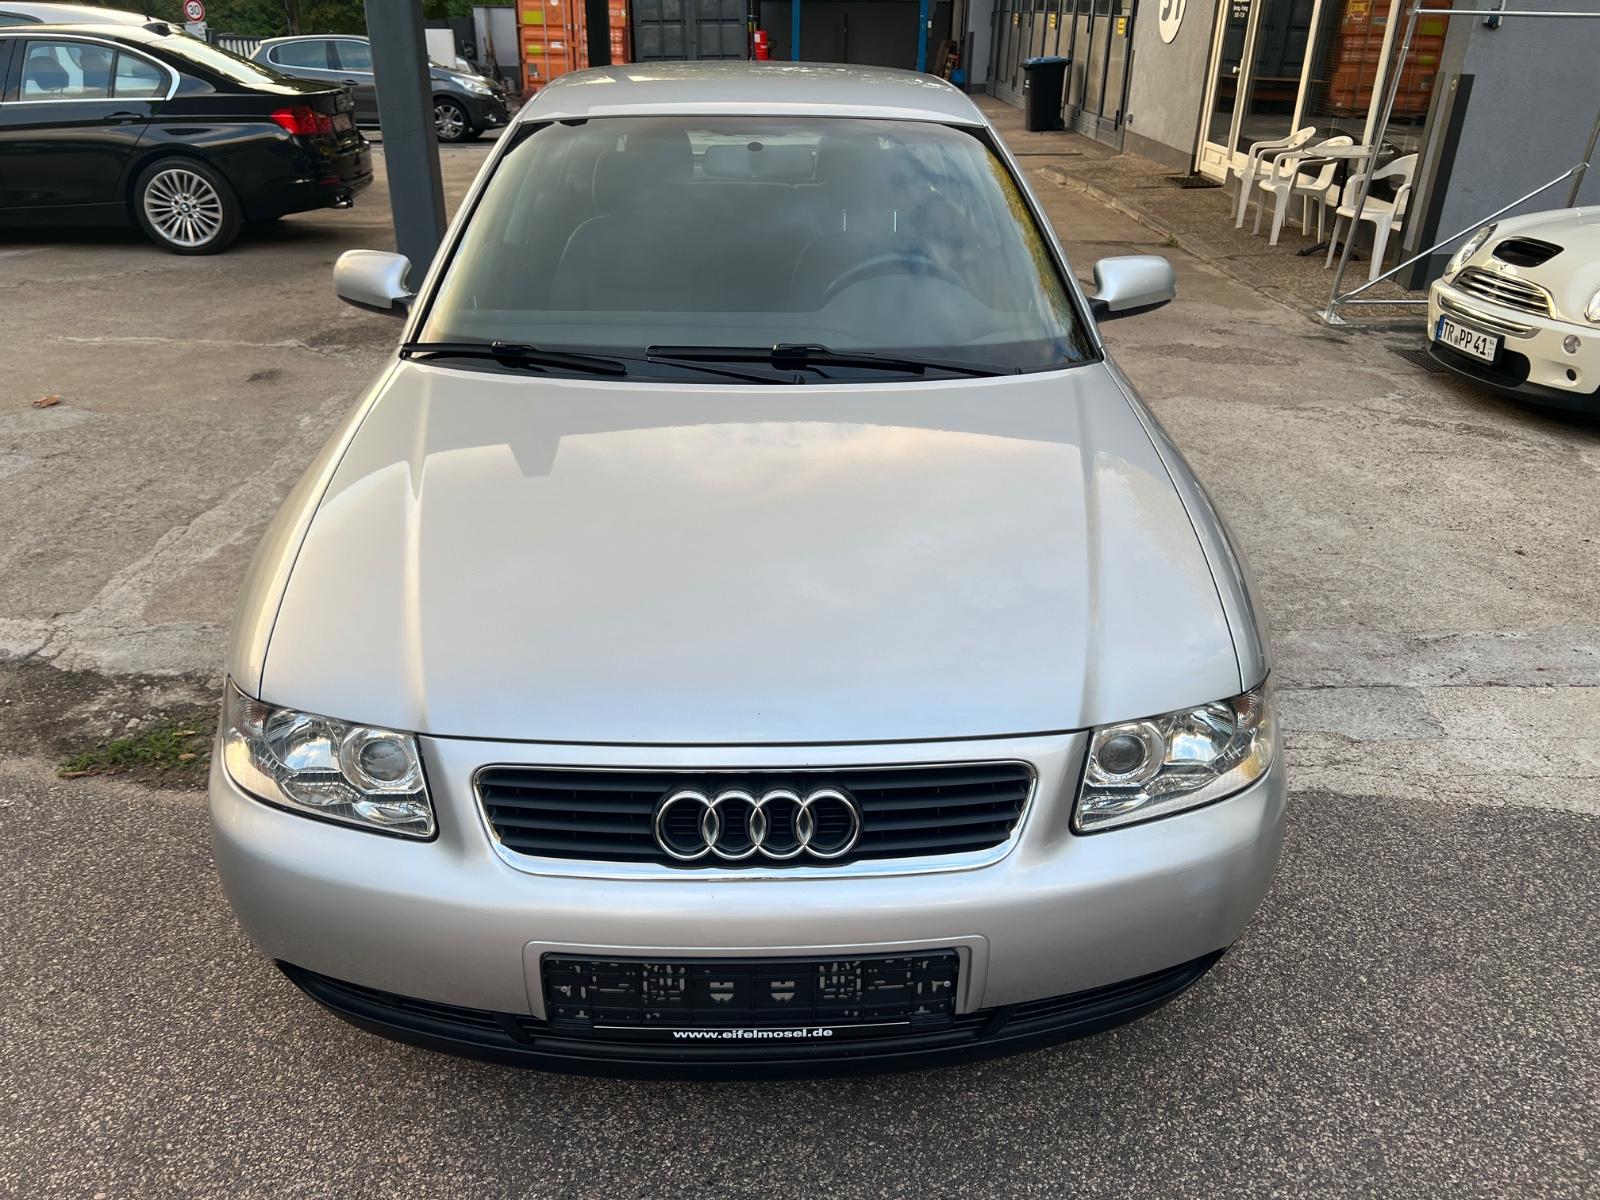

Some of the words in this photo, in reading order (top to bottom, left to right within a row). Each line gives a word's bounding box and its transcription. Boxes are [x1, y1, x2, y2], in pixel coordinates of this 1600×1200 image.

[189, 4, 200, 15] 30
[1443, 321, 1455, 342] TR
[1458, 328, 1473, 349] PP
[1473, 335, 1488, 356] 41
[673, 1029, 833, 1039] www.eifelmosel.de
